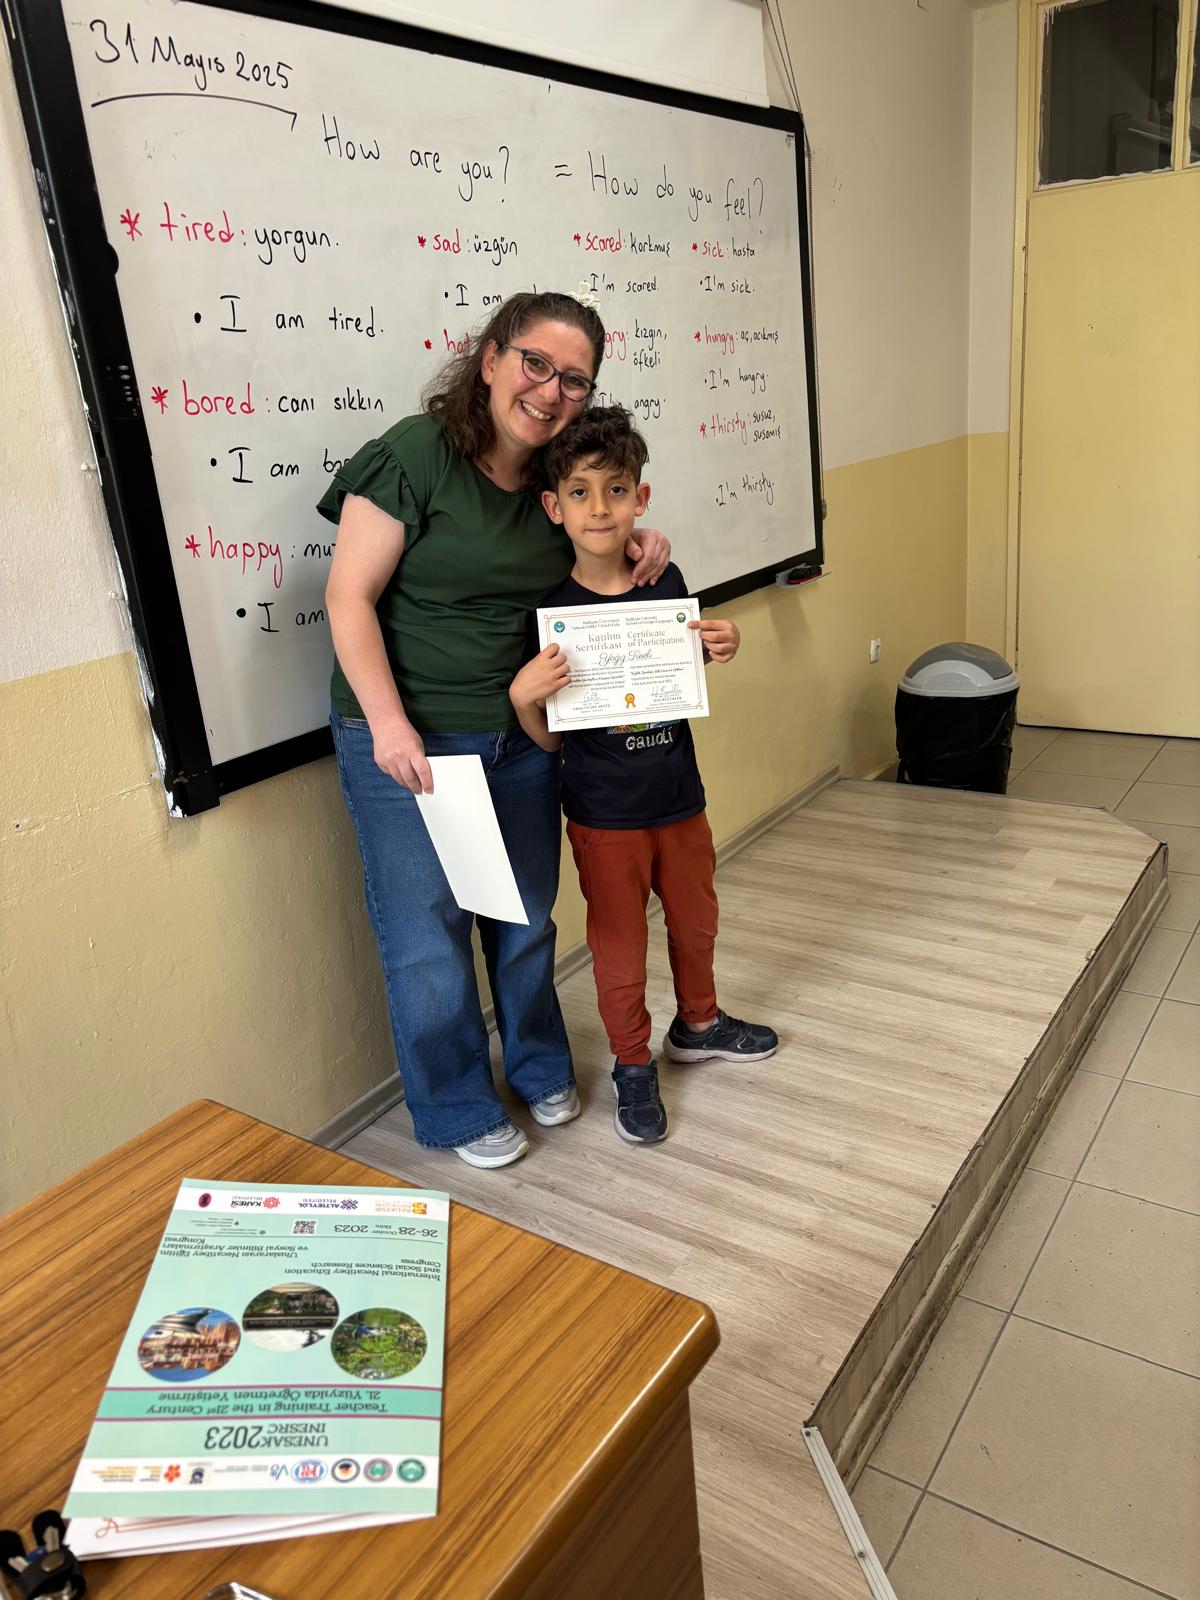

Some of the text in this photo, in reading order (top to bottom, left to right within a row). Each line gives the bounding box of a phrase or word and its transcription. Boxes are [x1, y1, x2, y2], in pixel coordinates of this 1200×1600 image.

[90, 19, 138, 63] 31
[236, 52, 293, 89] 2025
[322, 113, 380, 161] How
[410, 149, 442, 173] are
[458, 145, 510, 204] you?
[587, 150, 639, 195] How
[656, 164, 674, 199] do
[688, 185, 713, 222] you
[724, 177, 764, 236] feel?
[254, 229, 339, 265] yorgun.
[473, 234, 518, 266] üzgün
[732, 237, 755, 258] hasta
[590, 272, 615, 292] I'm
[704, 275, 756, 293] I'm sick.
[456, 283, 503, 306] I am
[220, 295, 384, 337] I am tired.
[709, 368, 730, 390] I'm
[228, 446, 253, 483] I
[270, 460, 300, 477] am
[719, 481, 738, 507] I'm
[257, 602, 325, 633] I am
[627, 629, 666, 640] Certificate
[627, 636, 684, 648] of Participation
[333, 1224, 369, 1234] 2023
[398, 1226, 438, 1238] 26-28
[192, 1250, 240, 1258] Necatibey
[355, 1262, 394, 1270] Sciences
[395, 1264, 422, 1272] Social
[400, 1258, 441, 1267] Congress
[333, 1268, 379, 1276] Necatibey
[381, 1270, 441, 1281] International
[145, 1403, 203, 1415] Century
[233, 1403, 254, 1413] the
[258, 1404, 271, 1414] in
[274, 1401, 331, 1414] Training
[334, 1403, 388, 1413] Teacher
[267, 1422, 327, 1434] INESRC
[204, 1425, 328, 1450] UNESAK 2023
